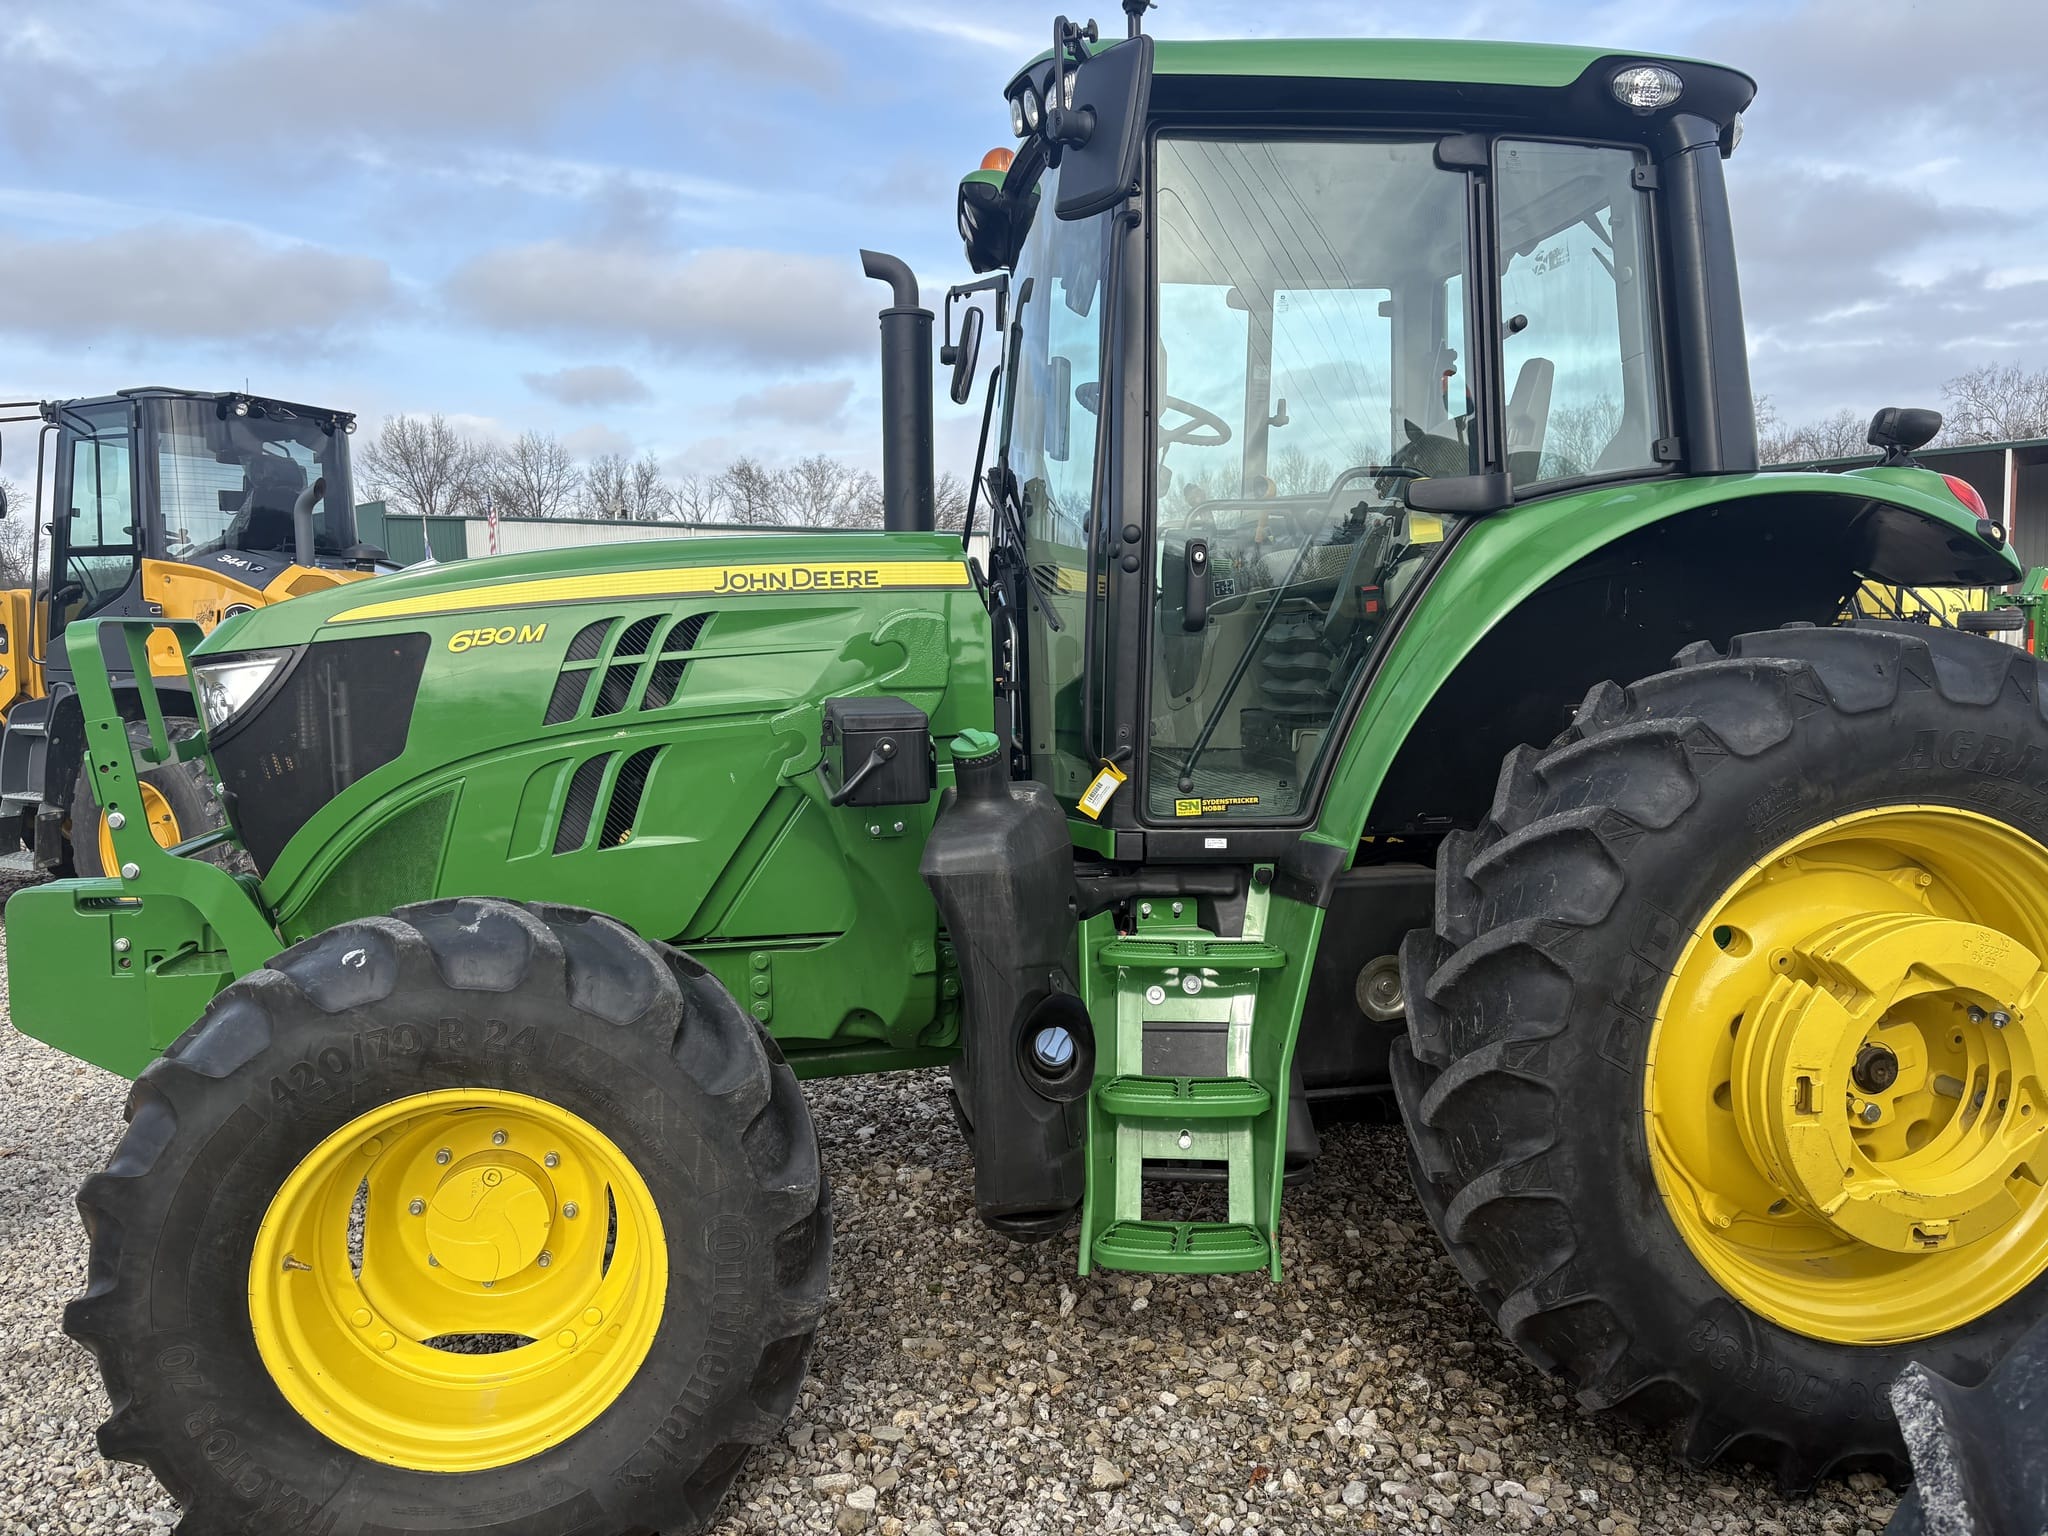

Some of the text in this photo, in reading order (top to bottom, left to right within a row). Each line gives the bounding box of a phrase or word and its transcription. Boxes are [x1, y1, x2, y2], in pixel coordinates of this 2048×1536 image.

[714, 568, 879, 591] JOHN DEERE
[1896, 728, 2048, 796] AGRI
[270, 1017, 537, 1105] 420/70 R 24
